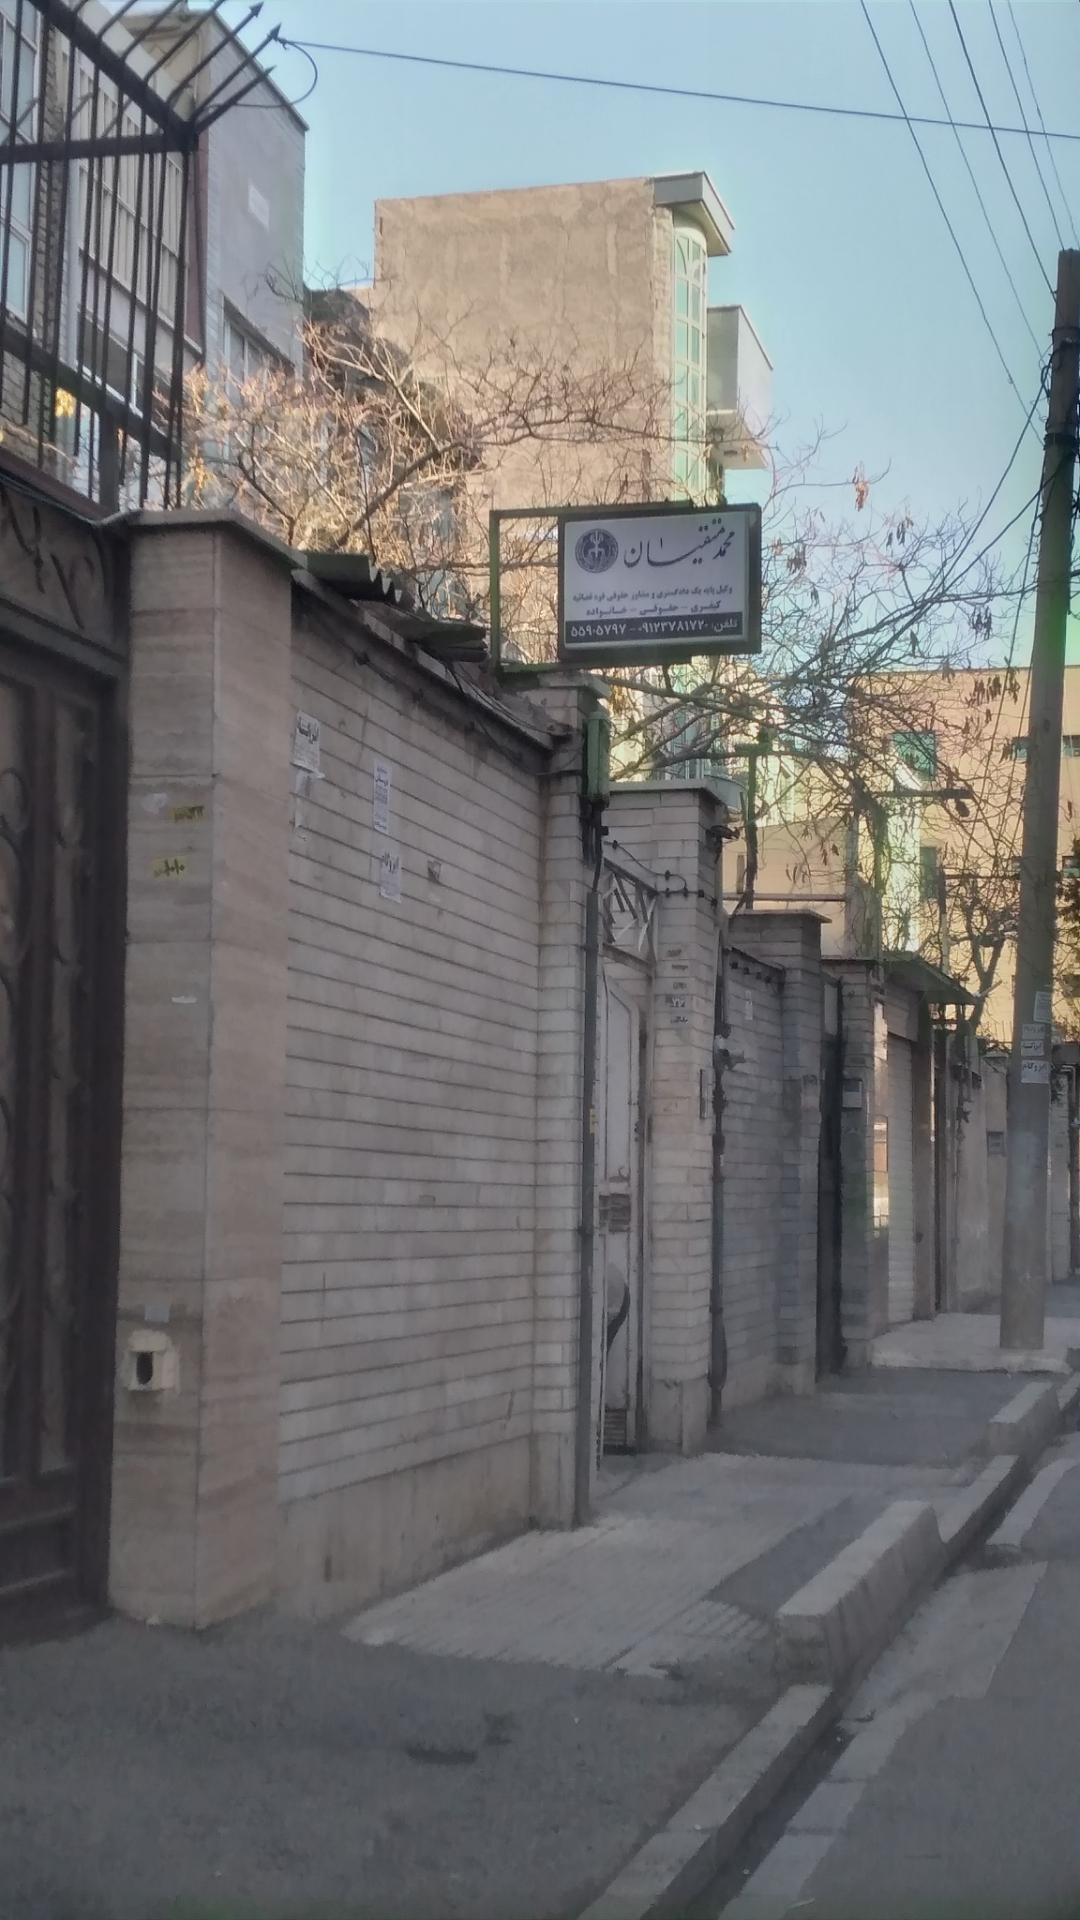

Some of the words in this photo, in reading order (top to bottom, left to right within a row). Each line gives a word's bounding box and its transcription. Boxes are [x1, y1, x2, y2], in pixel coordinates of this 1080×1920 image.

[713, 531, 735, 560] محمد
[631, 590, 650, 601] مشاور
[656, 588, 689, 599] دادگستری
[691, 586, 702, 595] یک
[703, 586, 715, 596] پایه
[716, 585, 733, 595] وکیل
[607, 591, 628, 602] حقوقی
[586, 606, 627, 618] خانواده
[639, 604, 678, 616] حقوقی
[690, 600, 721, 613] کیفری
[571, 623, 627, 637] ۵۵۹۰۵۷۹۷
